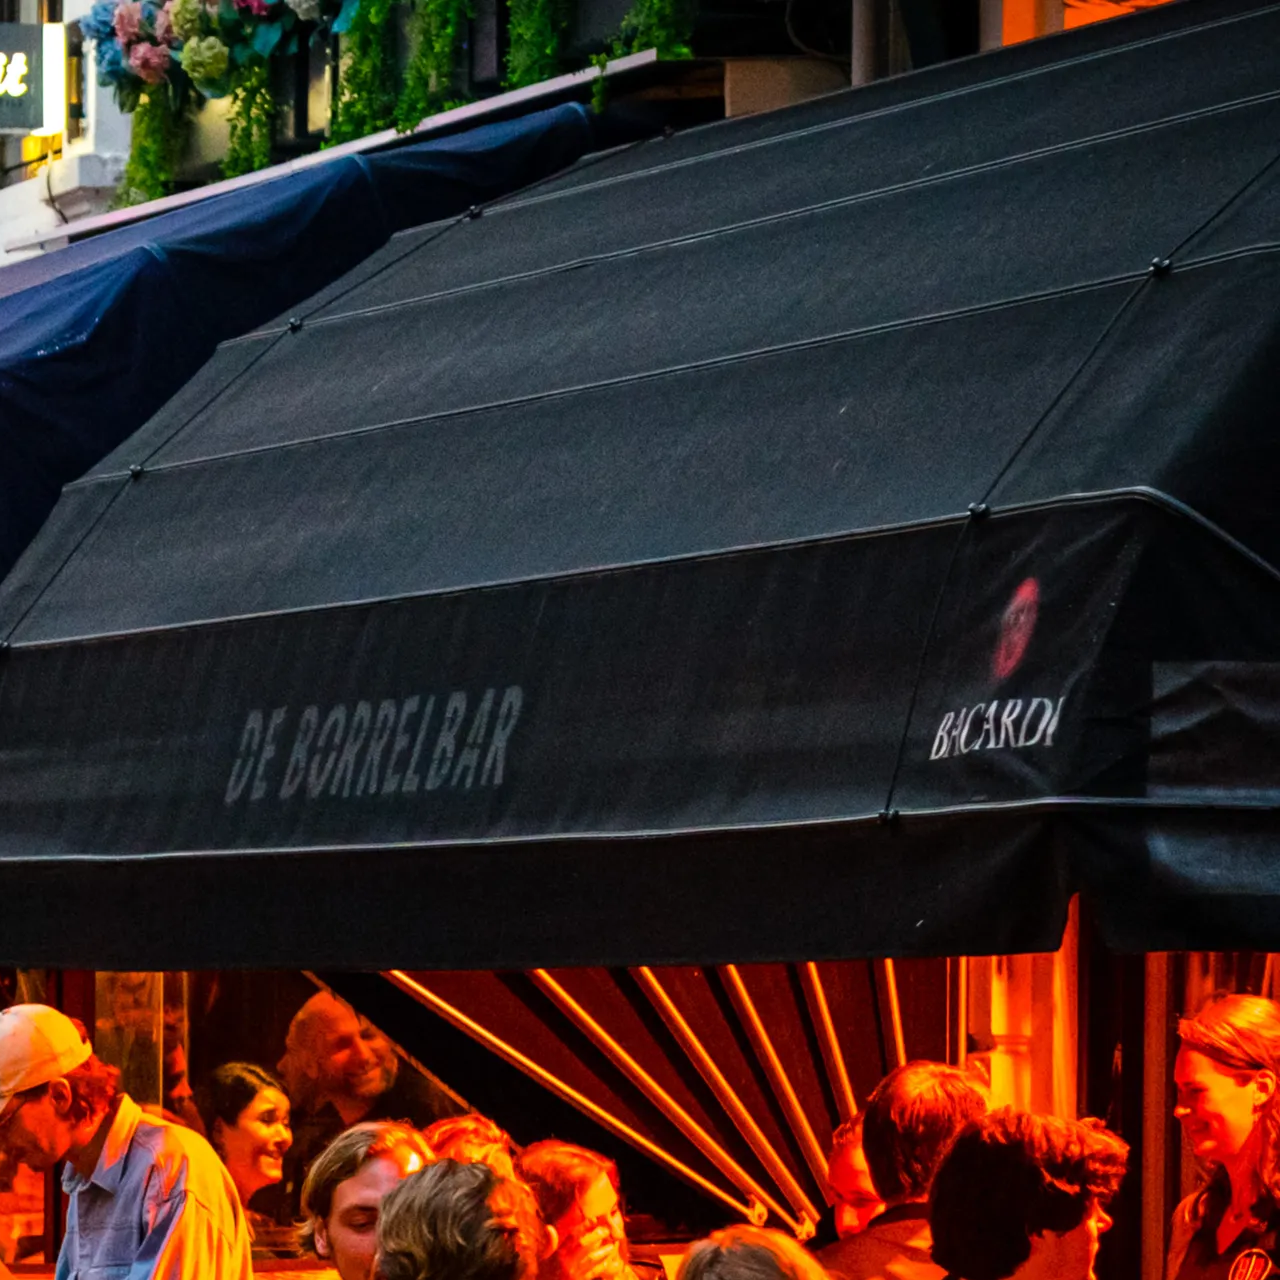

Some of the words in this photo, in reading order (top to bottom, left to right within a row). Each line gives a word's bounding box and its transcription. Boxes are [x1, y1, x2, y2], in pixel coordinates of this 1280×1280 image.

[224, 705, 287, 806] DE
[278, 685, 523, 799] BORRELBAR
[928, 696, 1066, 761] BACARDI
